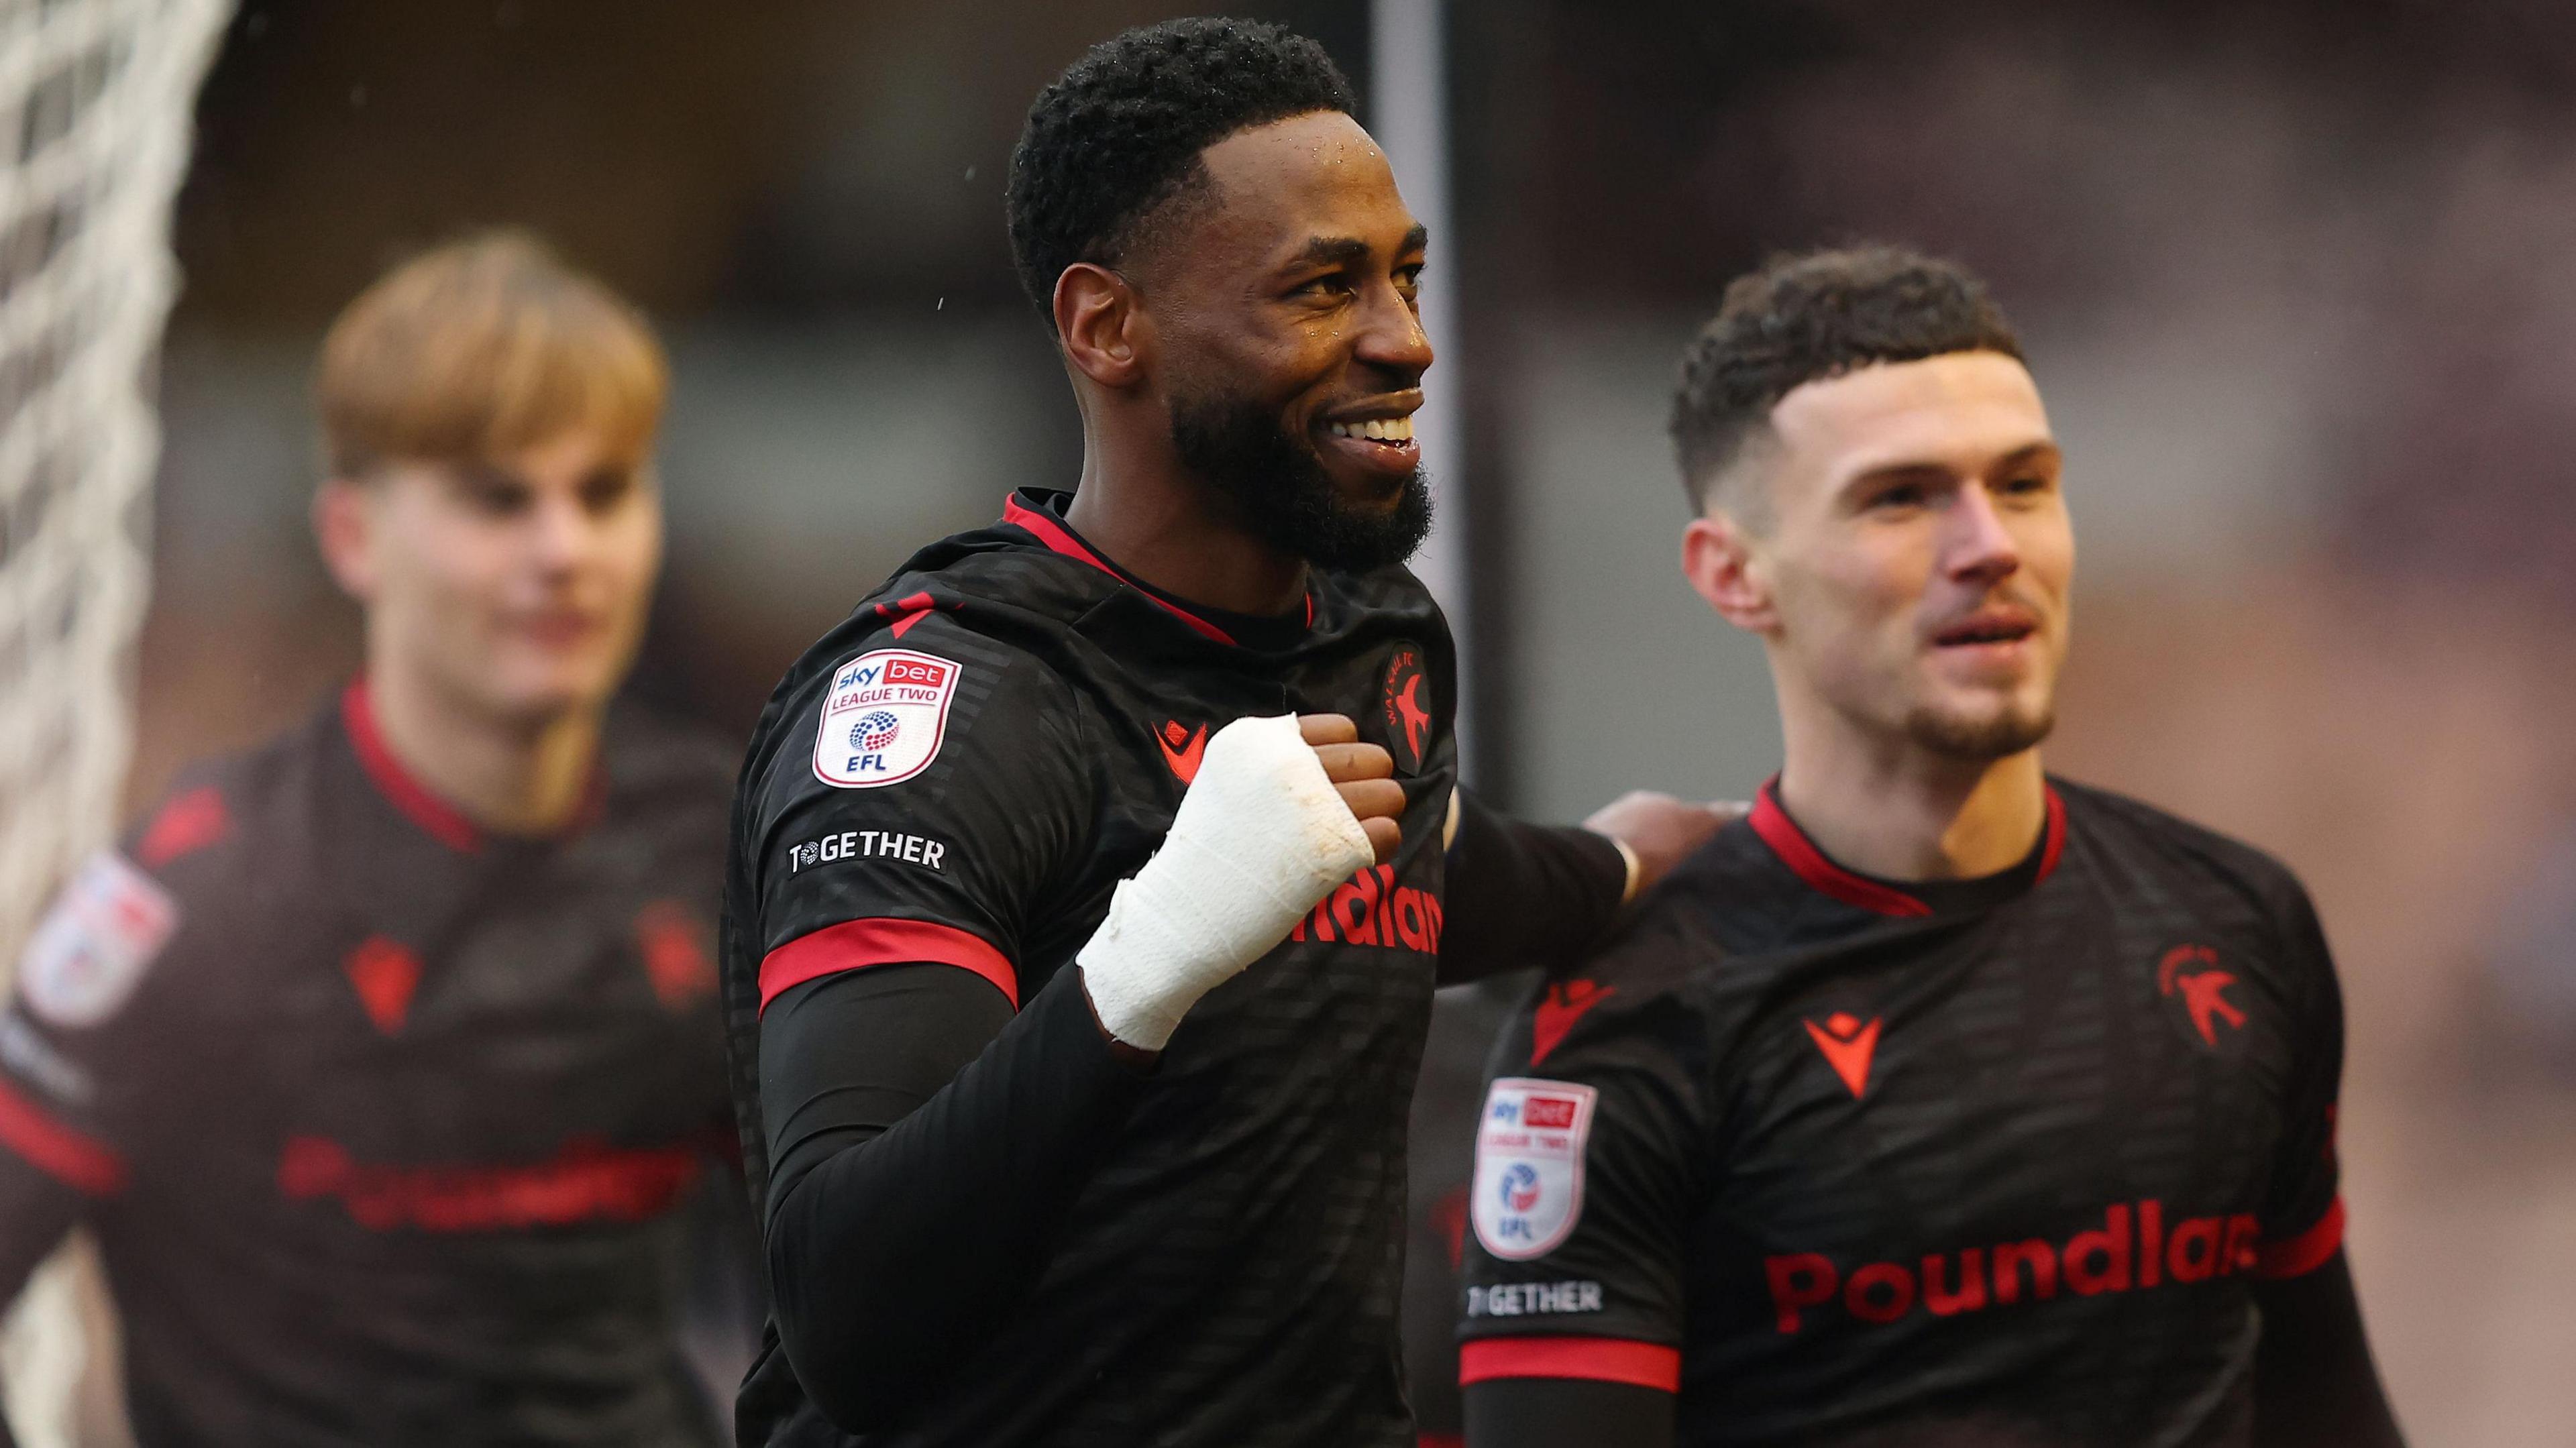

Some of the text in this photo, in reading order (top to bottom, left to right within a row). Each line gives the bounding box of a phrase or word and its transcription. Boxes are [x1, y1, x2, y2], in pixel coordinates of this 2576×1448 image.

[838, 661, 941, 690] sky bet
[833, 687, 938, 710] LEAGUE TWO
[847, 754, 887, 773] EFL
[789, 831, 945, 873] TOGETHER
